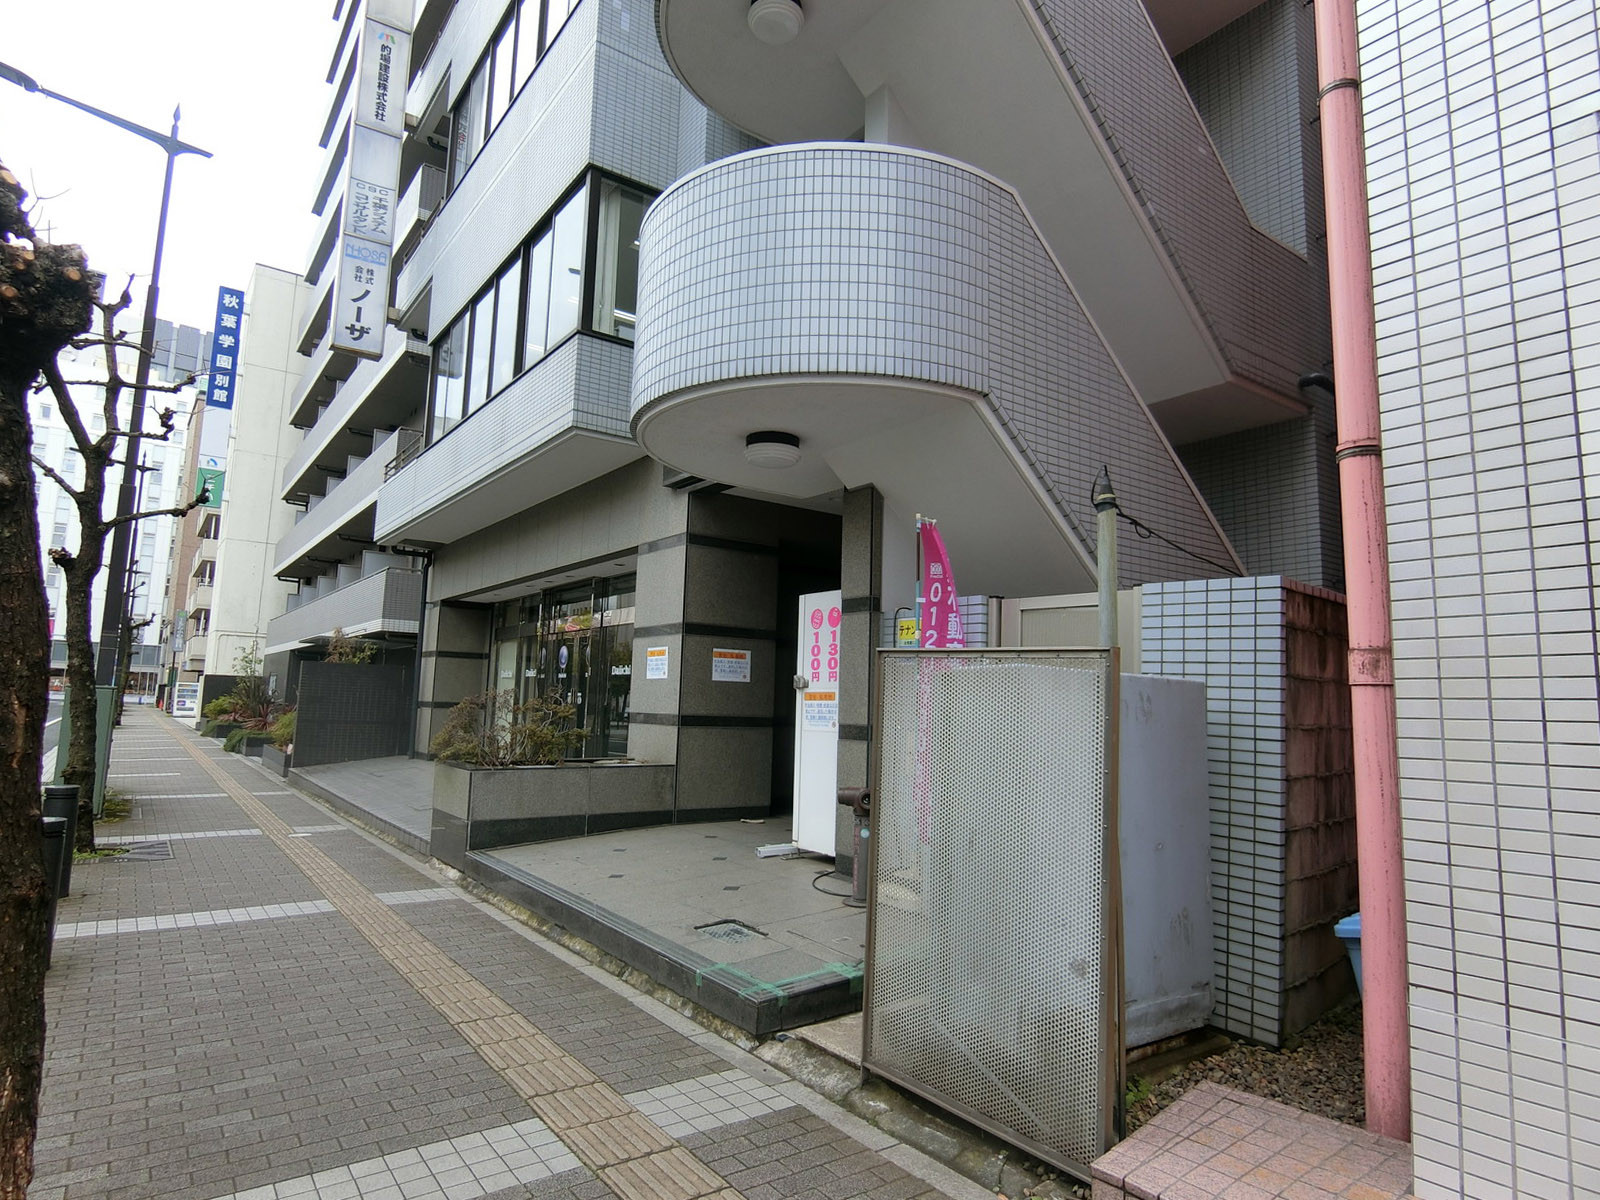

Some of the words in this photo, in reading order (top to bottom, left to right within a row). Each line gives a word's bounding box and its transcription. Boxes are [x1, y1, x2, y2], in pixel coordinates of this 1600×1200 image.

[356, 182, 389, 197] CSC
[344, 289, 372, 342] ノーザ
[212, 293, 240, 403] 秋葉学園別館
[811, 631, 821, 683] 100円
[827, 629, 839, 683] 130円
